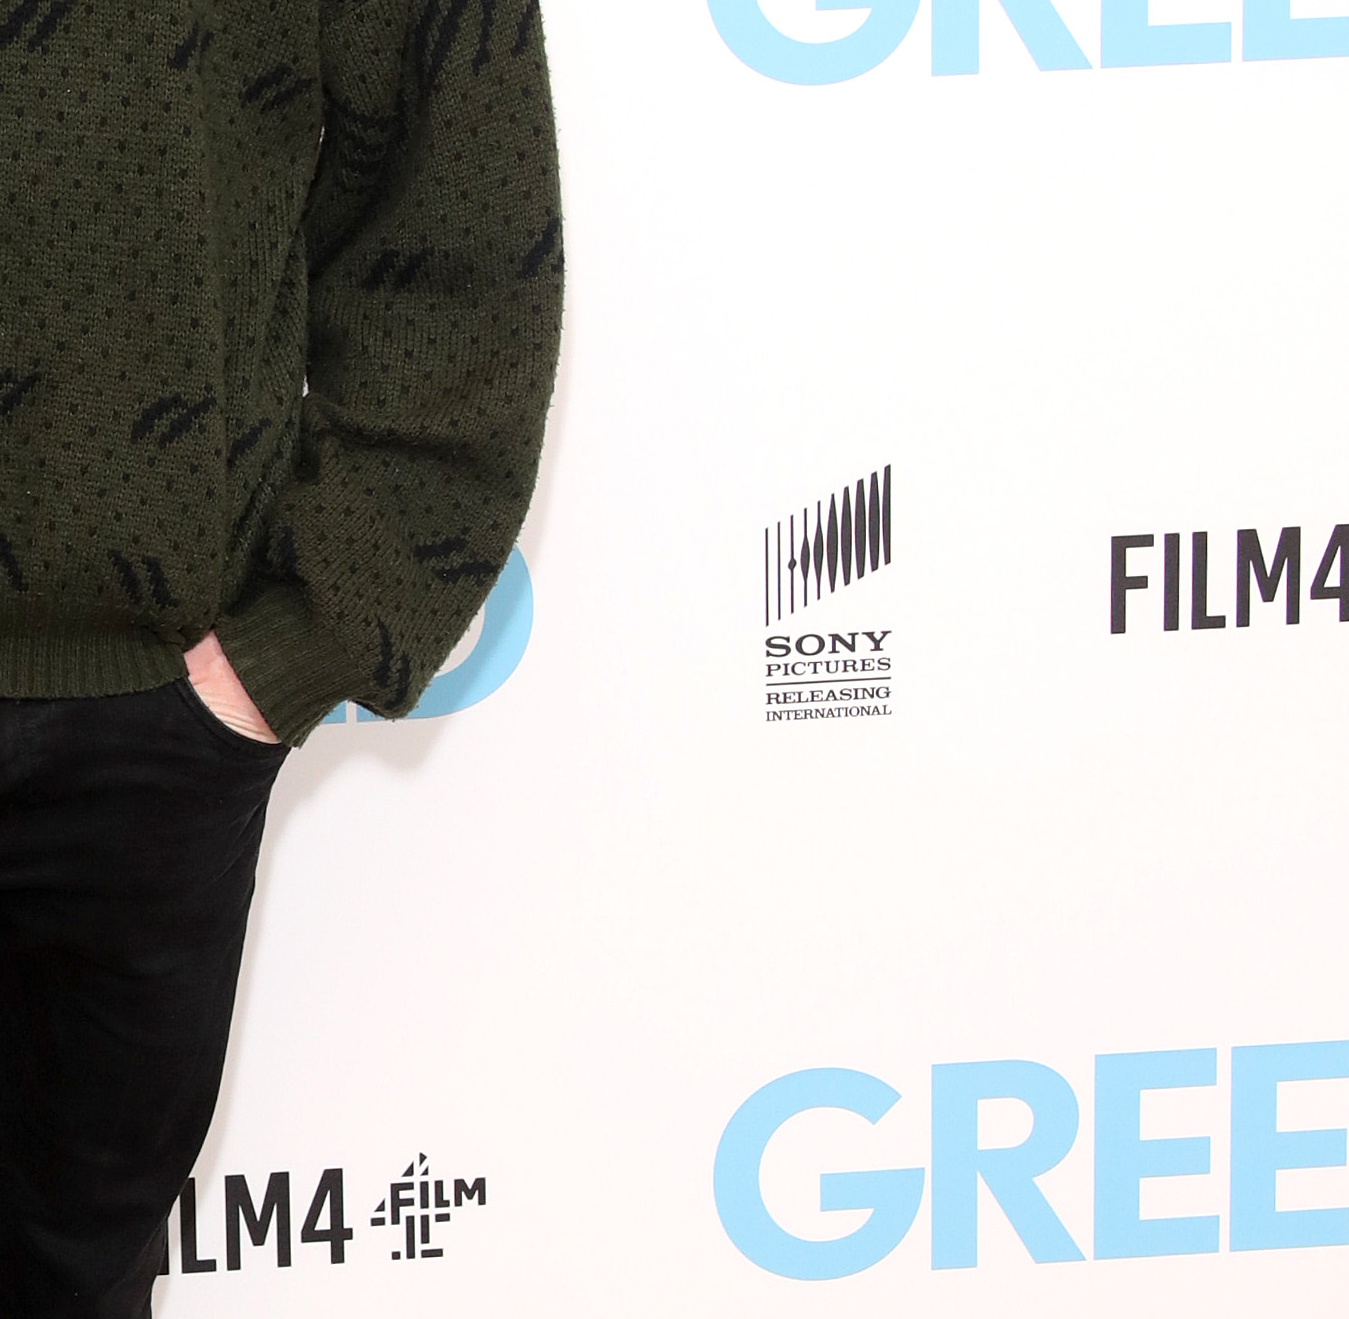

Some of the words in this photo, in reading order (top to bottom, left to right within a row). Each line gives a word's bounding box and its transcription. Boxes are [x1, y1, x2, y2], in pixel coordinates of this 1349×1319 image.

[765, 630, 892, 658] SONY
[766, 657, 891, 677] PICTURES
[766, 686, 891, 705] RELEASING
[766, 704, 892, 722] INTERNATIONAL
